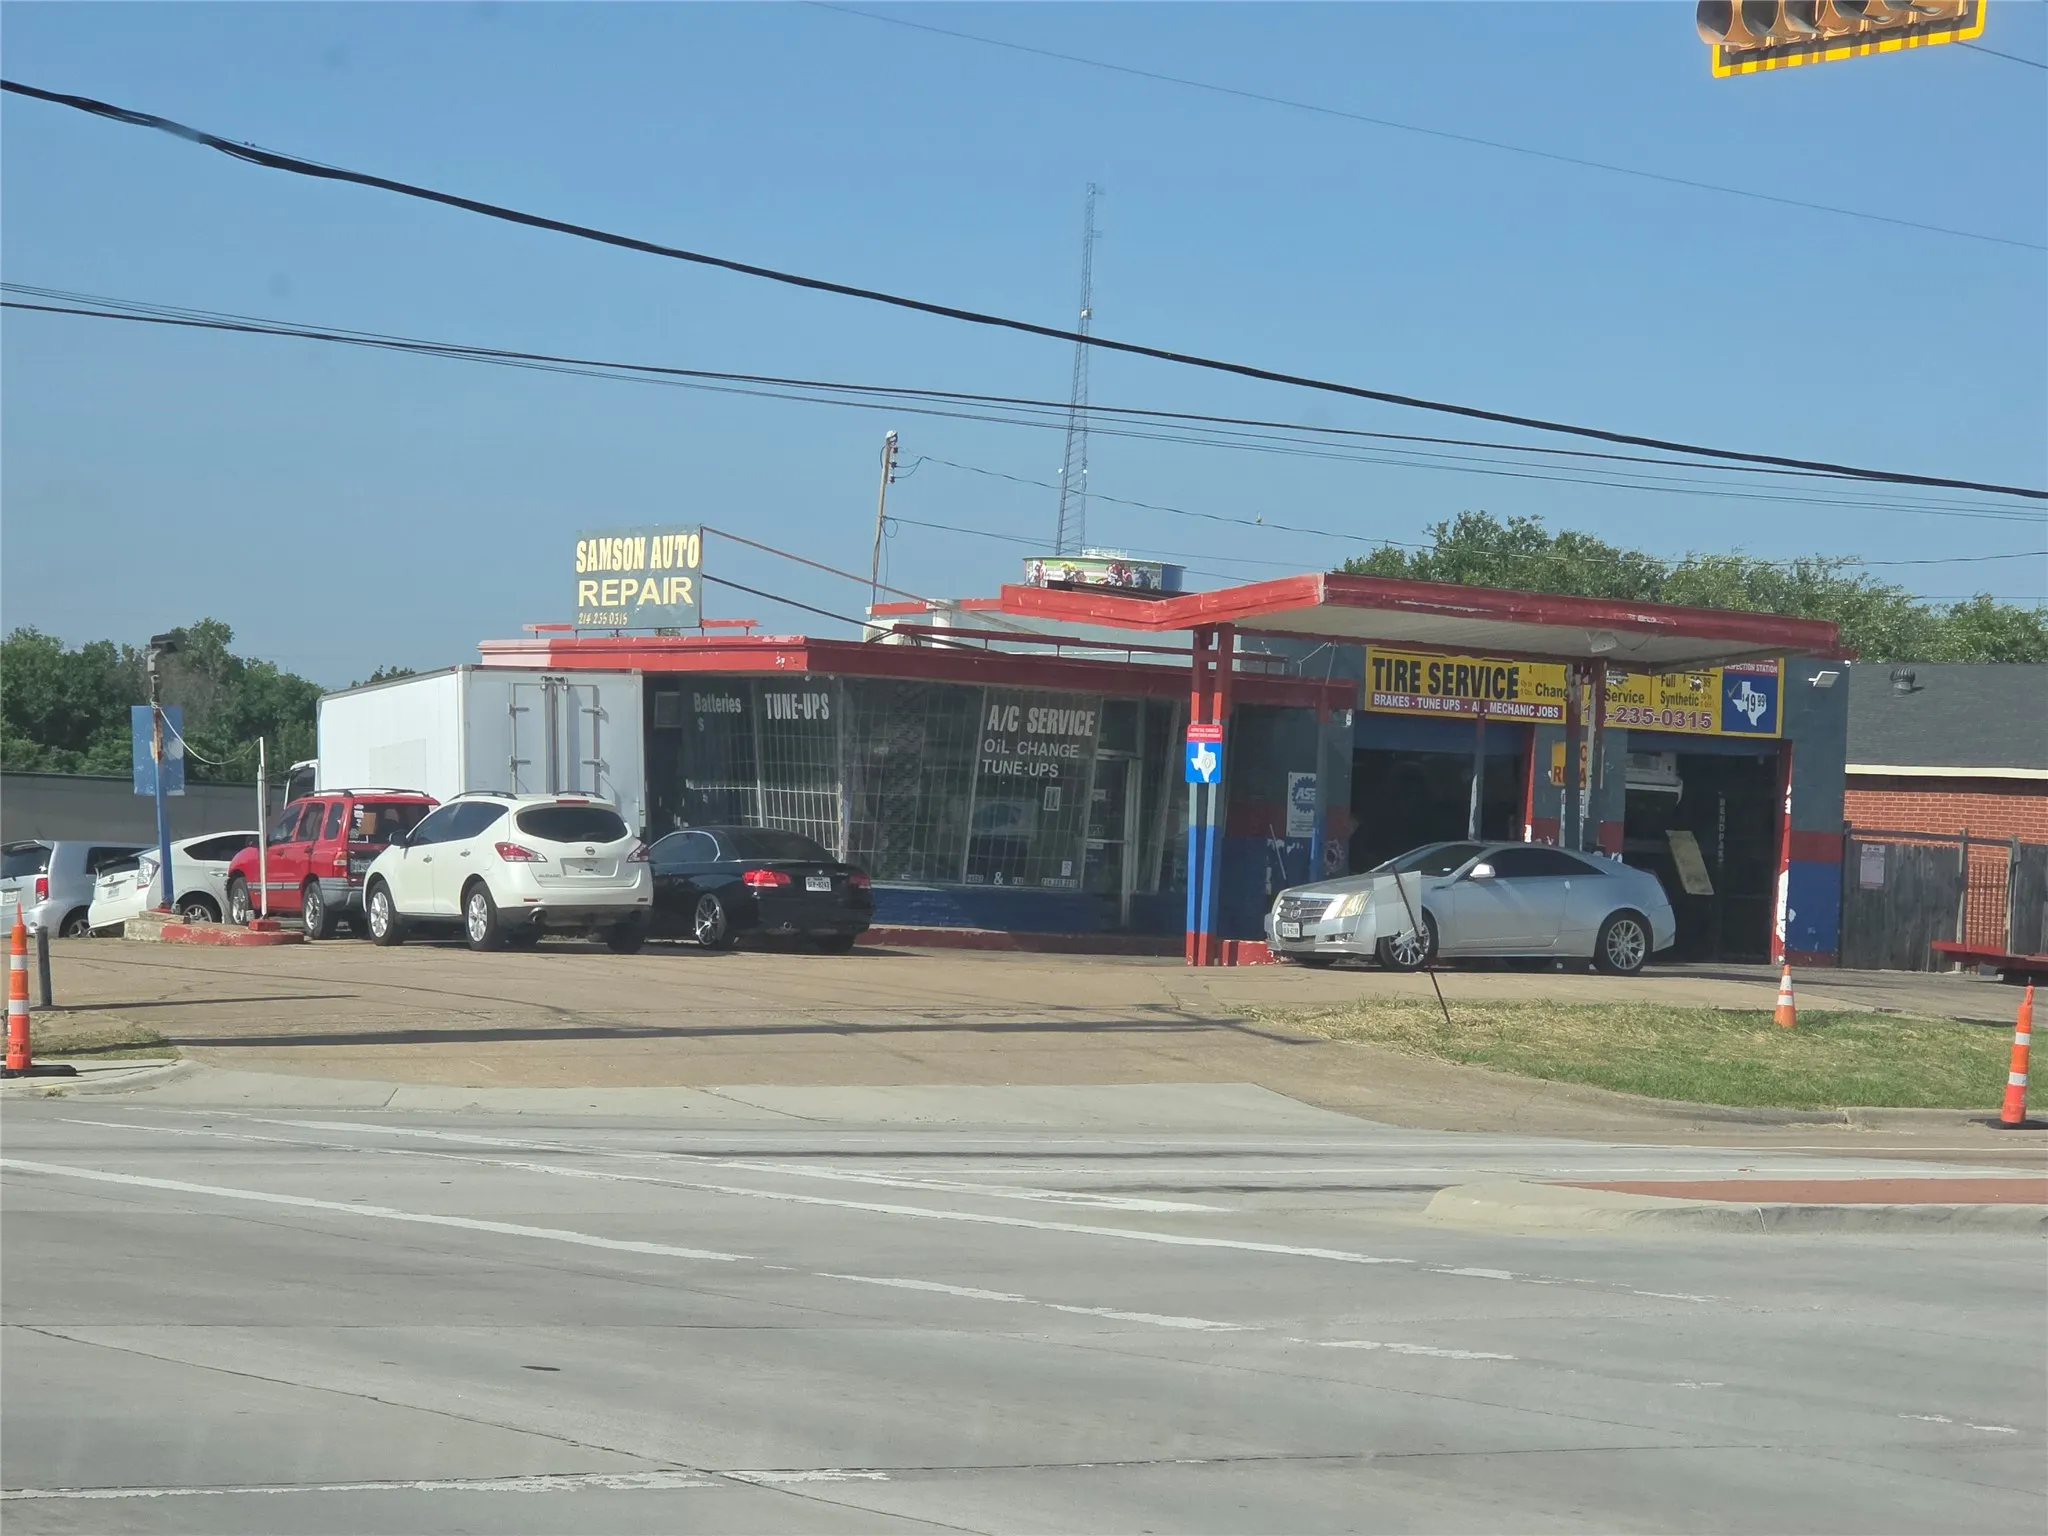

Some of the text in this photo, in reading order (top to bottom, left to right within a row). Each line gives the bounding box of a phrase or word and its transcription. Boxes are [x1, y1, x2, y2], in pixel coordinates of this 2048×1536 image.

[576, 534, 699, 573] SAMSON AUTO
[578, 577, 693, 607] REPAIR
[1373, 657, 1520, 700] TIRE SERVICE
[1756, 664, 1778, 673] STATION
[1535, 683, 1569, 702] Chang
[1660, 674, 1676, 688] Full
[693, 692, 741, 713] Batteries
[765, 692, 830, 720] TUNE-UPS
[1374, 693, 1410, 708] BRAKES
[1417, 697, 1441, 710] TUNE
[1443, 699, 1460, 712] UPS
[1490, 702, 1534, 716] MECHANIC
[1536, 705, 1559, 718] JOBS
[1660, 691, 1700, 708] Synthetic
[987, 704, 1095, 737] A/C SERVICE
[1017, 741, 1080, 758] CHANGE
